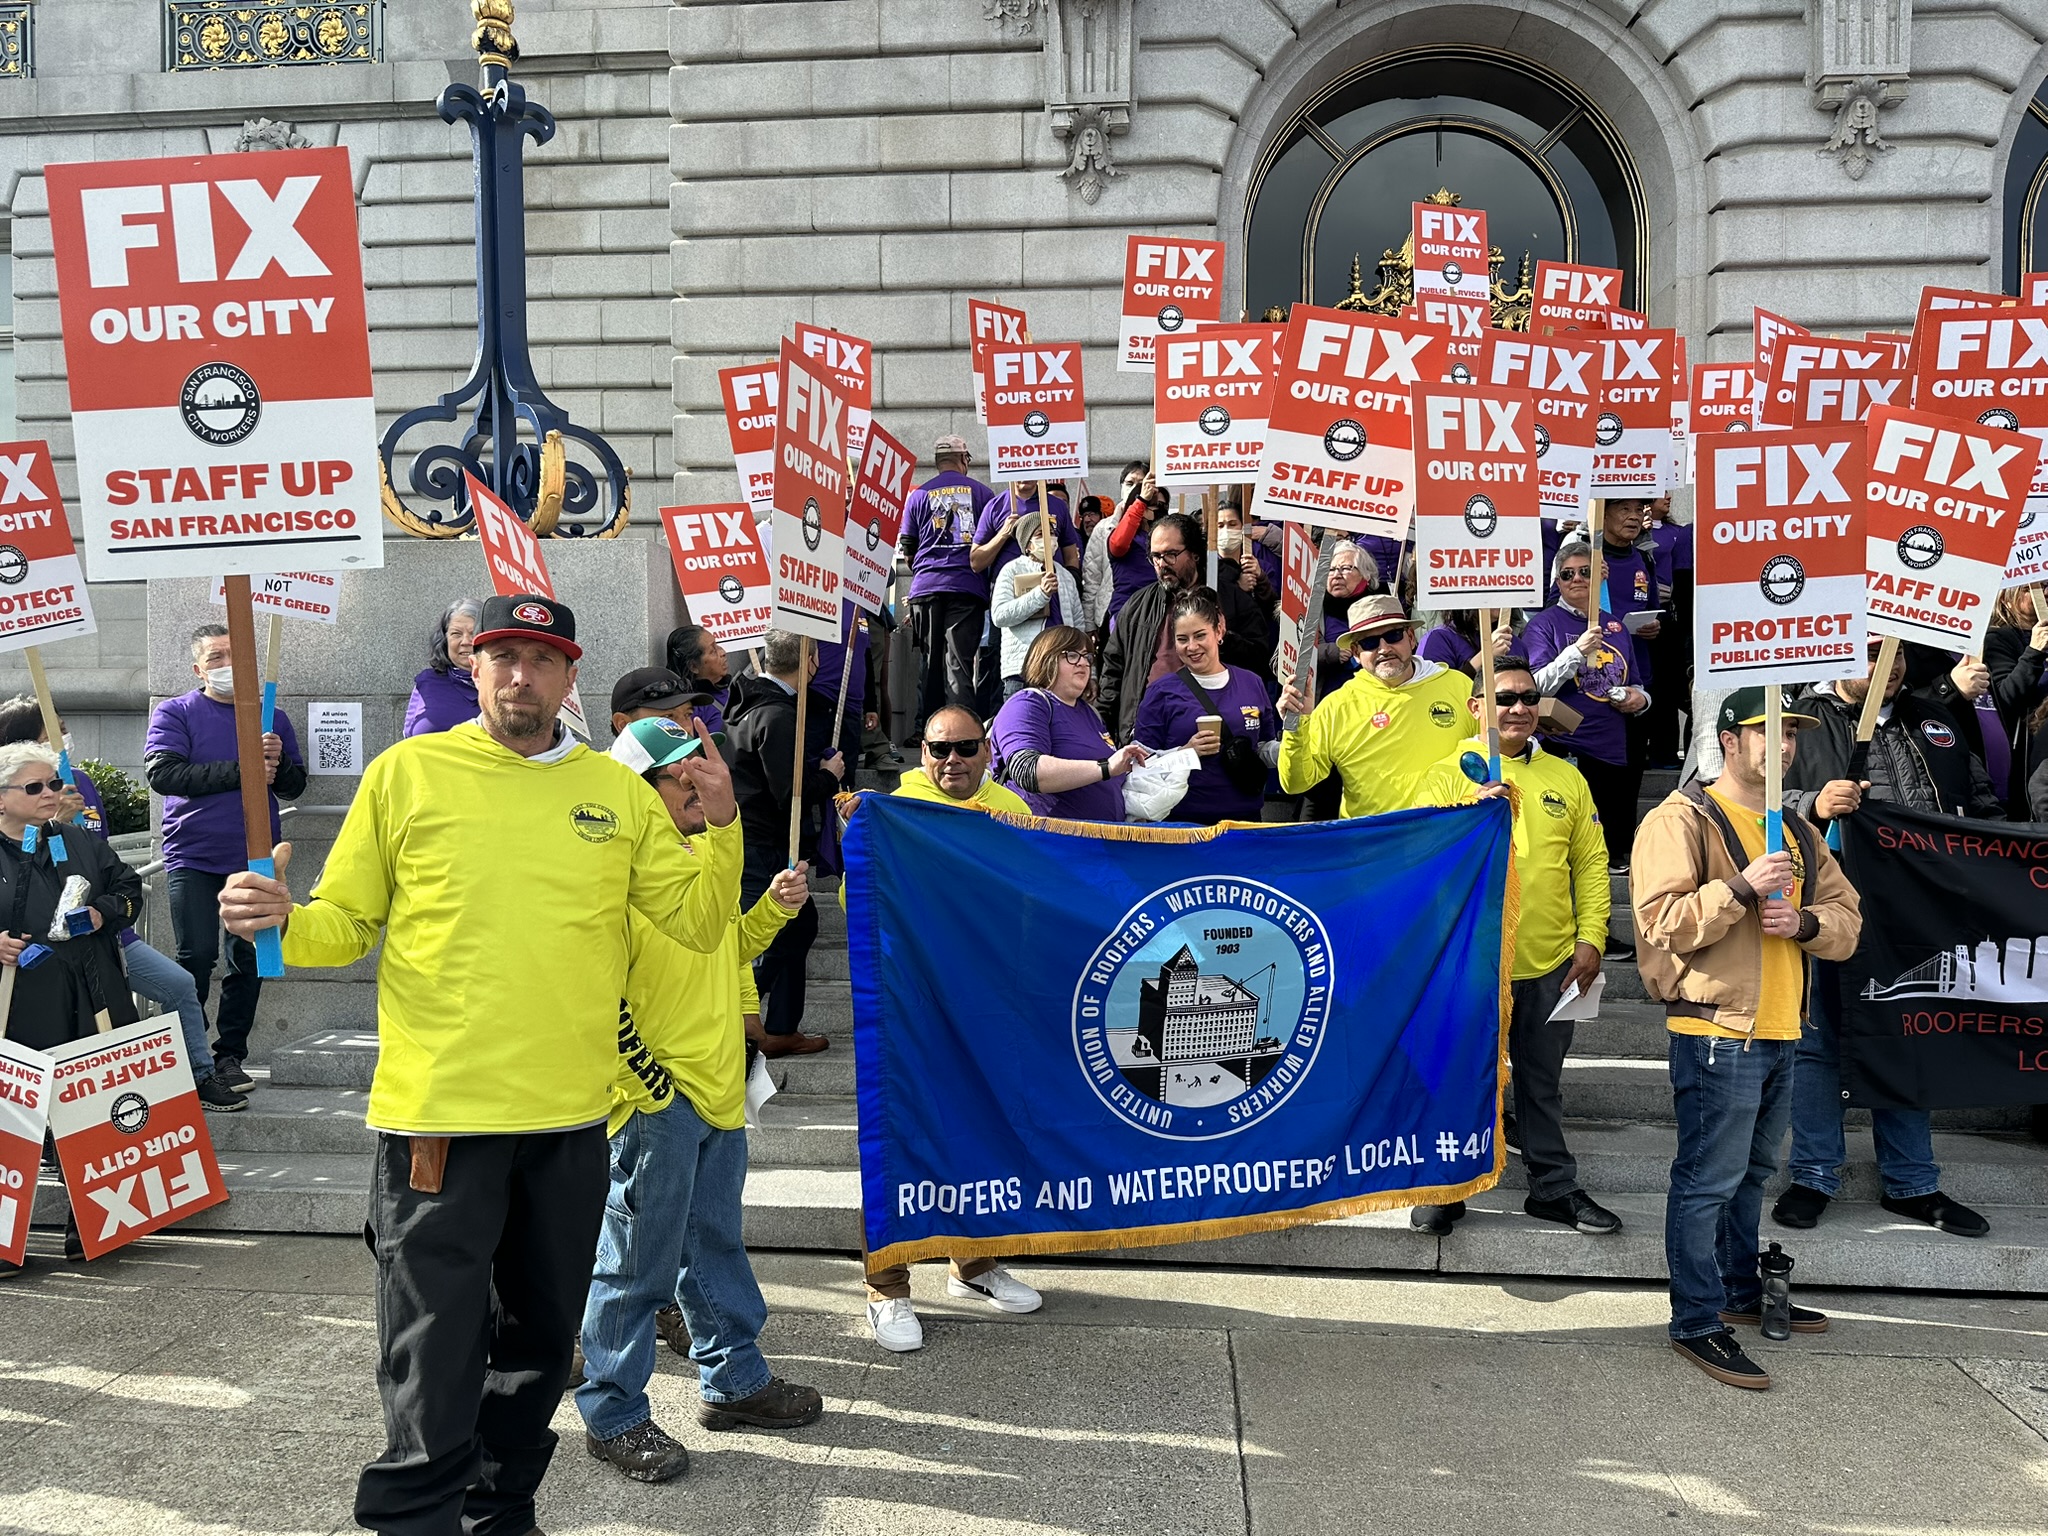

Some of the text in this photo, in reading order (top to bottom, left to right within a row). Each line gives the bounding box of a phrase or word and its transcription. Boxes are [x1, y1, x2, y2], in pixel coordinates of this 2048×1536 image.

[81, 175, 334, 288] FIX
[1421, 209, 1482, 245] FIX
[1135, 243, 1216, 281] FIX
[1421, 243, 1482, 259] OUR CITY
[1133, 282, 1213, 300] OUR CITY
[1542, 268, 1615, 305] FIX
[90, 297, 335, 345] OUR CITY
[975, 307, 1023, 345] FIX
[1539, 304, 1573, 319] OUR
[1128, 351, 1148, 360] SAN
[1167, 338, 1263, 380] FIX
[1297, 318, 1435, 386] FIX
[993, 350, 1074, 387] FIX
[1490, 340, 1594, 396] FIX
[184, 366, 256, 402] SAN FRANCISCO
[994, 390, 1032, 405] OUR
[1034, 388, 1075, 403] CITY
[1166, 381, 1263, 400] OUR CITY
[1290, 379, 1350, 407] OUR
[1608, 386, 1661, 404] CITY
[1932, 377, 1993, 398] OUR
[786, 358, 843, 462] FIX
[1537, 398, 1589, 419] CITY
[1699, 404, 1736, 416] OUR
[1806, 379, 1903, 421] FIX
[187, 408, 257, 442] CITY WORKERS
[1425, 395, 1527, 454] FIX
[997, 442, 1079, 459] PROTECT
[998, 457, 1080, 469] PUBLIC SERVICES
[1165, 441, 1264, 458] STAFF UP
[1872, 418, 2025, 501] FIX
[783, 442, 842, 495] OUR CITY
[864, 433, 911, 501] FIX
[1166, 460, 1190, 471] SAN
[1271, 461, 1404, 497] STAFF UP
[1427, 459, 1476, 482] OUR
[1479, 461, 1527, 483] CITY
[1597, 472, 1656, 482] SERVICES
[1714, 441, 1853, 510] FIX
[105, 459, 353, 505] STAFF UP
[941, 487, 955, 495] OUR
[957, 486, 971, 494] CITY
[859, 482, 899, 522] OUR CITY
[1268, 485, 1398, 516] SAN FRANCISCO
[1867, 481, 2006, 529] OUR CITY
[110, 508, 357, 540] SAN FRANCISCO
[476, 489, 549, 589] FIX
[672, 511, 754, 551] FIX
[1712, 514, 1853, 545] OUR CITY
[1901, 527, 1943, 550] SAN FRANCISCO
[684, 551, 757, 572] OUR CITY
[846, 545, 887, 578] PUBLIC SERVICES
[1429, 548, 1534, 569] STAFF UP
[1762, 556, 1803, 579] SAN FRANCISCO
[1899, 547, 1939, 568] CITY WORKERS
[2016, 544, 2042, 564] NOT
[265, 579, 292, 593] NOT
[493, 553, 526, 591] OUR
[779, 553, 839, 595] STAFF UP
[857, 569, 870, 583] NOT
[1429, 574, 1534, 588] SAN FRANCISCO
[778, 586, 837, 616] SAN FRANCISCO
[864, 589, 881, 606] GREED
[1287, 574, 1303, 603] OUR
[1763, 582, 1803, 603] CITY WORKERS
[1866, 568, 1981, 612] TAFF UP
[17, 607, 82, 628] SERVICES
[284, 598, 331, 615] GREED
[700, 608, 752, 628] STAFF
[1870, 598, 1974, 632] FRANCISCO
[1712, 613, 1853, 644] PROTECT
[1710, 642, 1854, 665] PUBLIC SERVICES
[1877, 825, 1939, 853] SAN
[1164, 884, 1315, 944] WATERPROOFERS
[1203, 926, 1253, 941] FOUNDED
[1215, 943, 1240, 955] 1903
[1304, 942, 1326, 979] AND
[1082, 994, 1100, 1018] OF
[1295, 985, 1326, 1049] ALLIED
[1902, 1011, 2044, 1037] ROOFERS
[54, 1034, 172, 1080] SAN FRANCISCO
[1082, 1027, 1115, 1085] UNION
[15, 1066, 42, 1085] SAN
[59, 1050, 177, 1103] STAFF UP
[1227, 1056, 1305, 1123] WORKERS
[112, 1094, 145, 1115] CITY WORKERS
[1110, 1084, 1173, 1129] UNITED
[114, 1119, 143, 1132] FRANCISCO
[83, 1125, 196, 1184] OUR CITY
[898, 1126, 1491, 1217] ROOFERS AND WATERPROOFERS LOCAL #40
[86, 1149, 211, 1243] FIX
